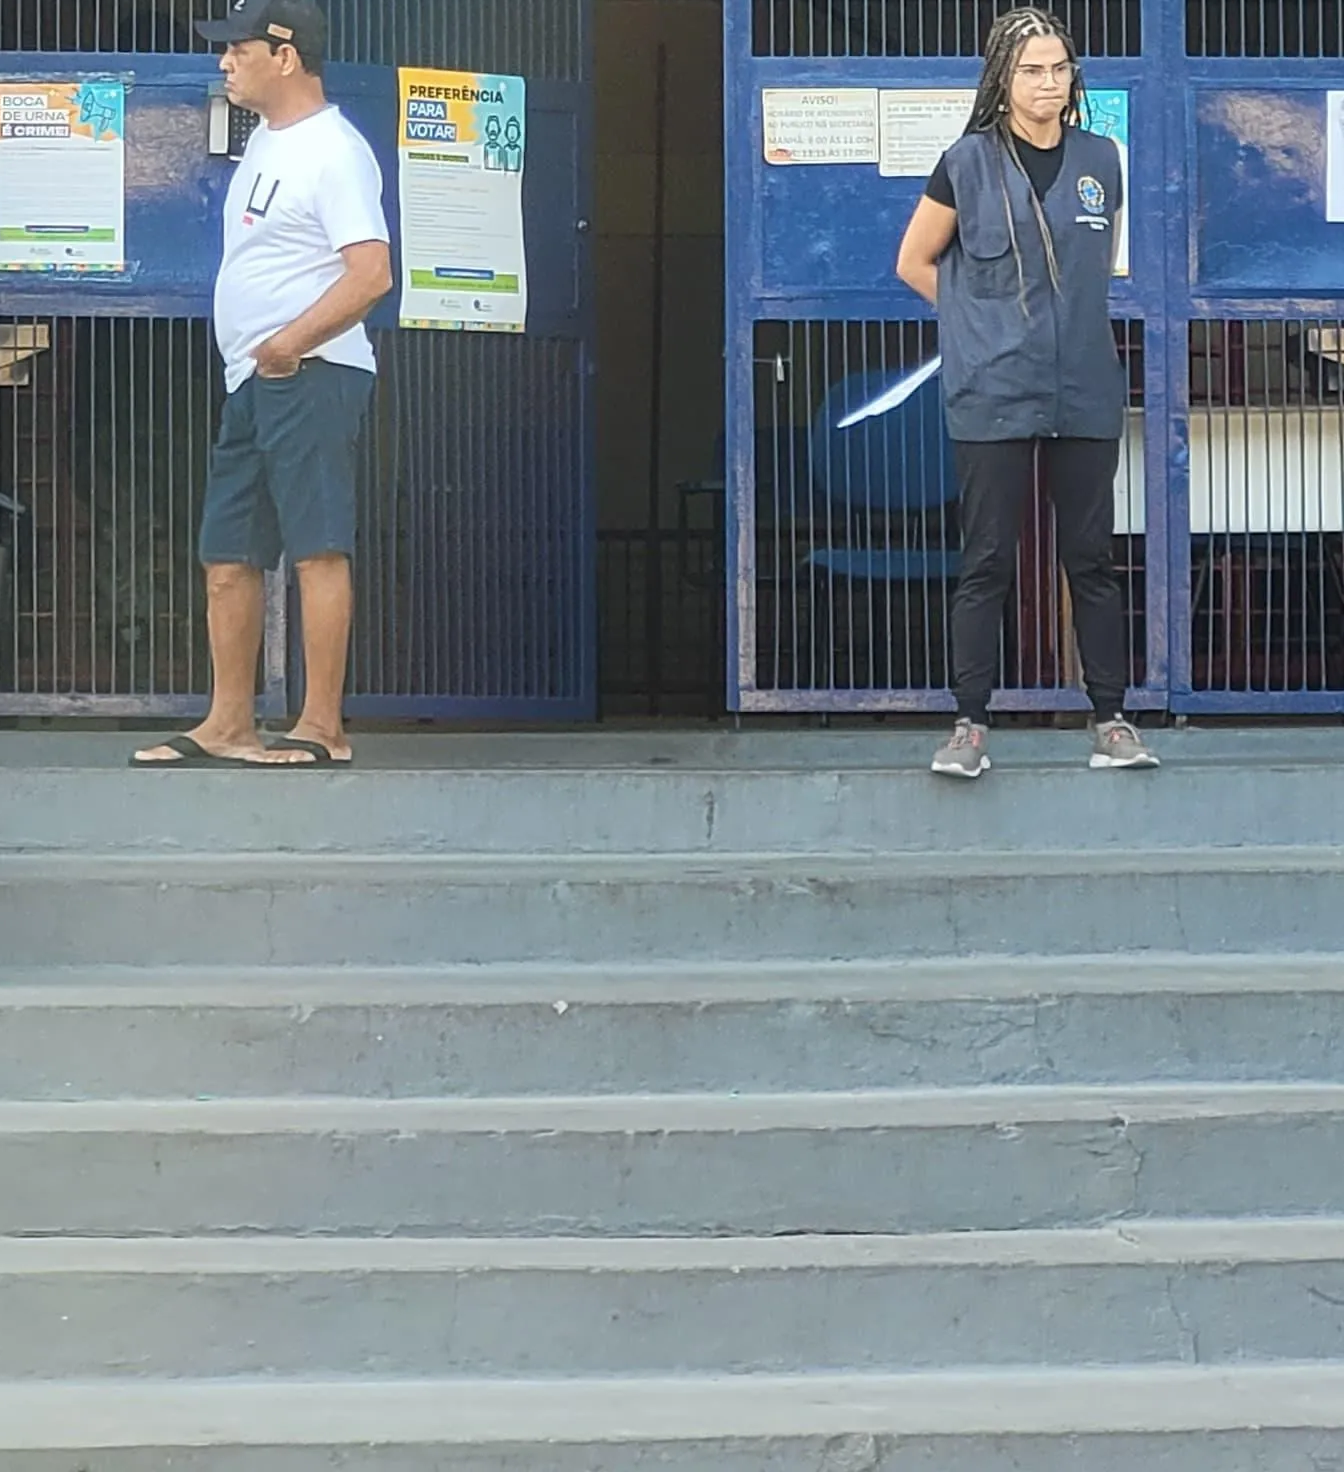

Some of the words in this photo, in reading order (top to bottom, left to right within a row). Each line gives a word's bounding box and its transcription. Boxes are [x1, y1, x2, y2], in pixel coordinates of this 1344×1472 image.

[409, 83, 504, 104] PREFERÊNCIA
[2, 96, 45, 107] BOCA
[2, 111, 20, 121] DE
[25, 111, 65, 121] URNA
[408, 103, 445, 118] PARA
[2, 124, 12, 137] É
[408, 123, 456, 139] VOTAR!
